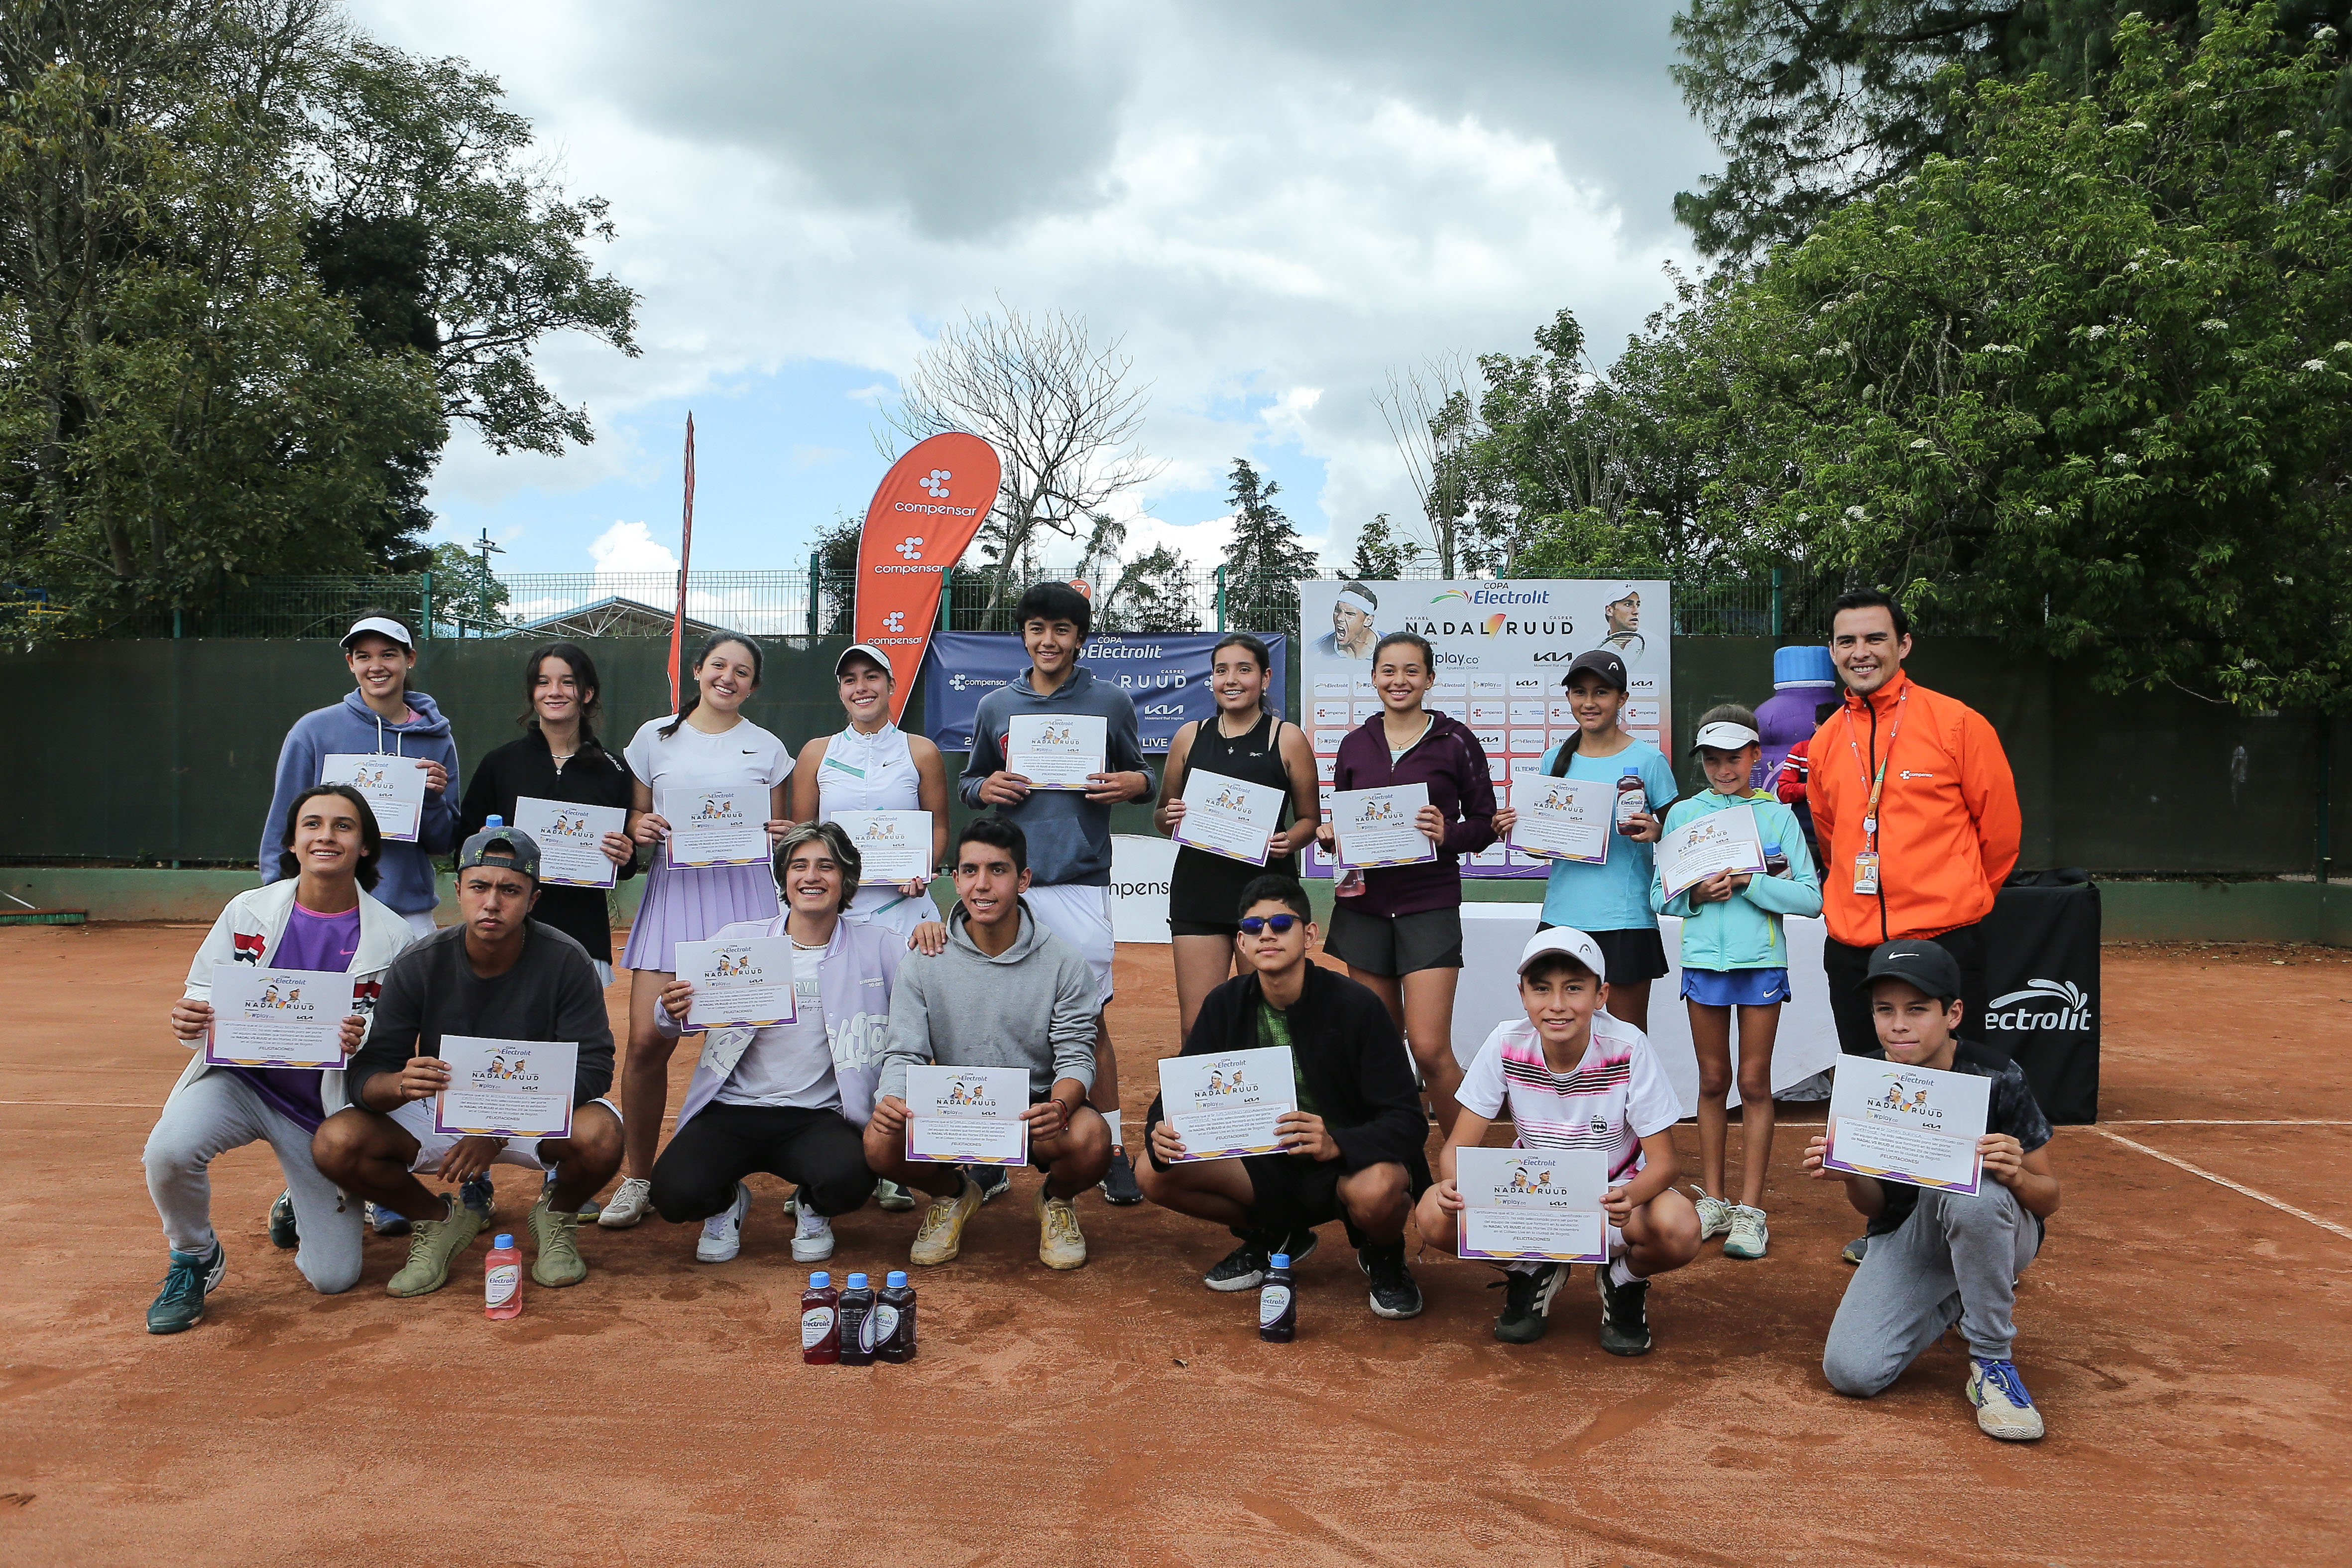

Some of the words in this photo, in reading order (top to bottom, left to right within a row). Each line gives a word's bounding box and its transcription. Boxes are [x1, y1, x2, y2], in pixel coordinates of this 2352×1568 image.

[895, 502, 976, 516] compensar
[874, 565, 945, 575] compensar
[1474, 591, 1549, 604] Electrolit
[1406, 622, 1490, 635] NADAL
[1506, 621, 1573, 634] RUUD
[867, 636, 922, 646] compensar
[1087, 644, 1162, 659] Electrolit
[1121, 675, 1187, 688] RUUD
[1143, 738, 1168, 747] LIVE
[1230, 784, 1251, 794] Electrolit
[1205, 799, 1229, 809] NADAL
[1233, 806, 1252, 815] RUUD
[1693, 818, 1716, 830] Electrolit
[1678, 840, 1703, 853] NADAL
[1706, 831, 1728, 840] RUUD
[1986, 1007, 2091, 1030] ectrolit
[1218, 1060, 1247, 1069] Electrolit
[1900, 1075, 1935, 1086] Electrolit
[1233, 1085, 1259, 1093] RUUD
[1867, 1099, 1904, 1112] NADAL
[1911, 1106, 1943, 1118] RUUD
